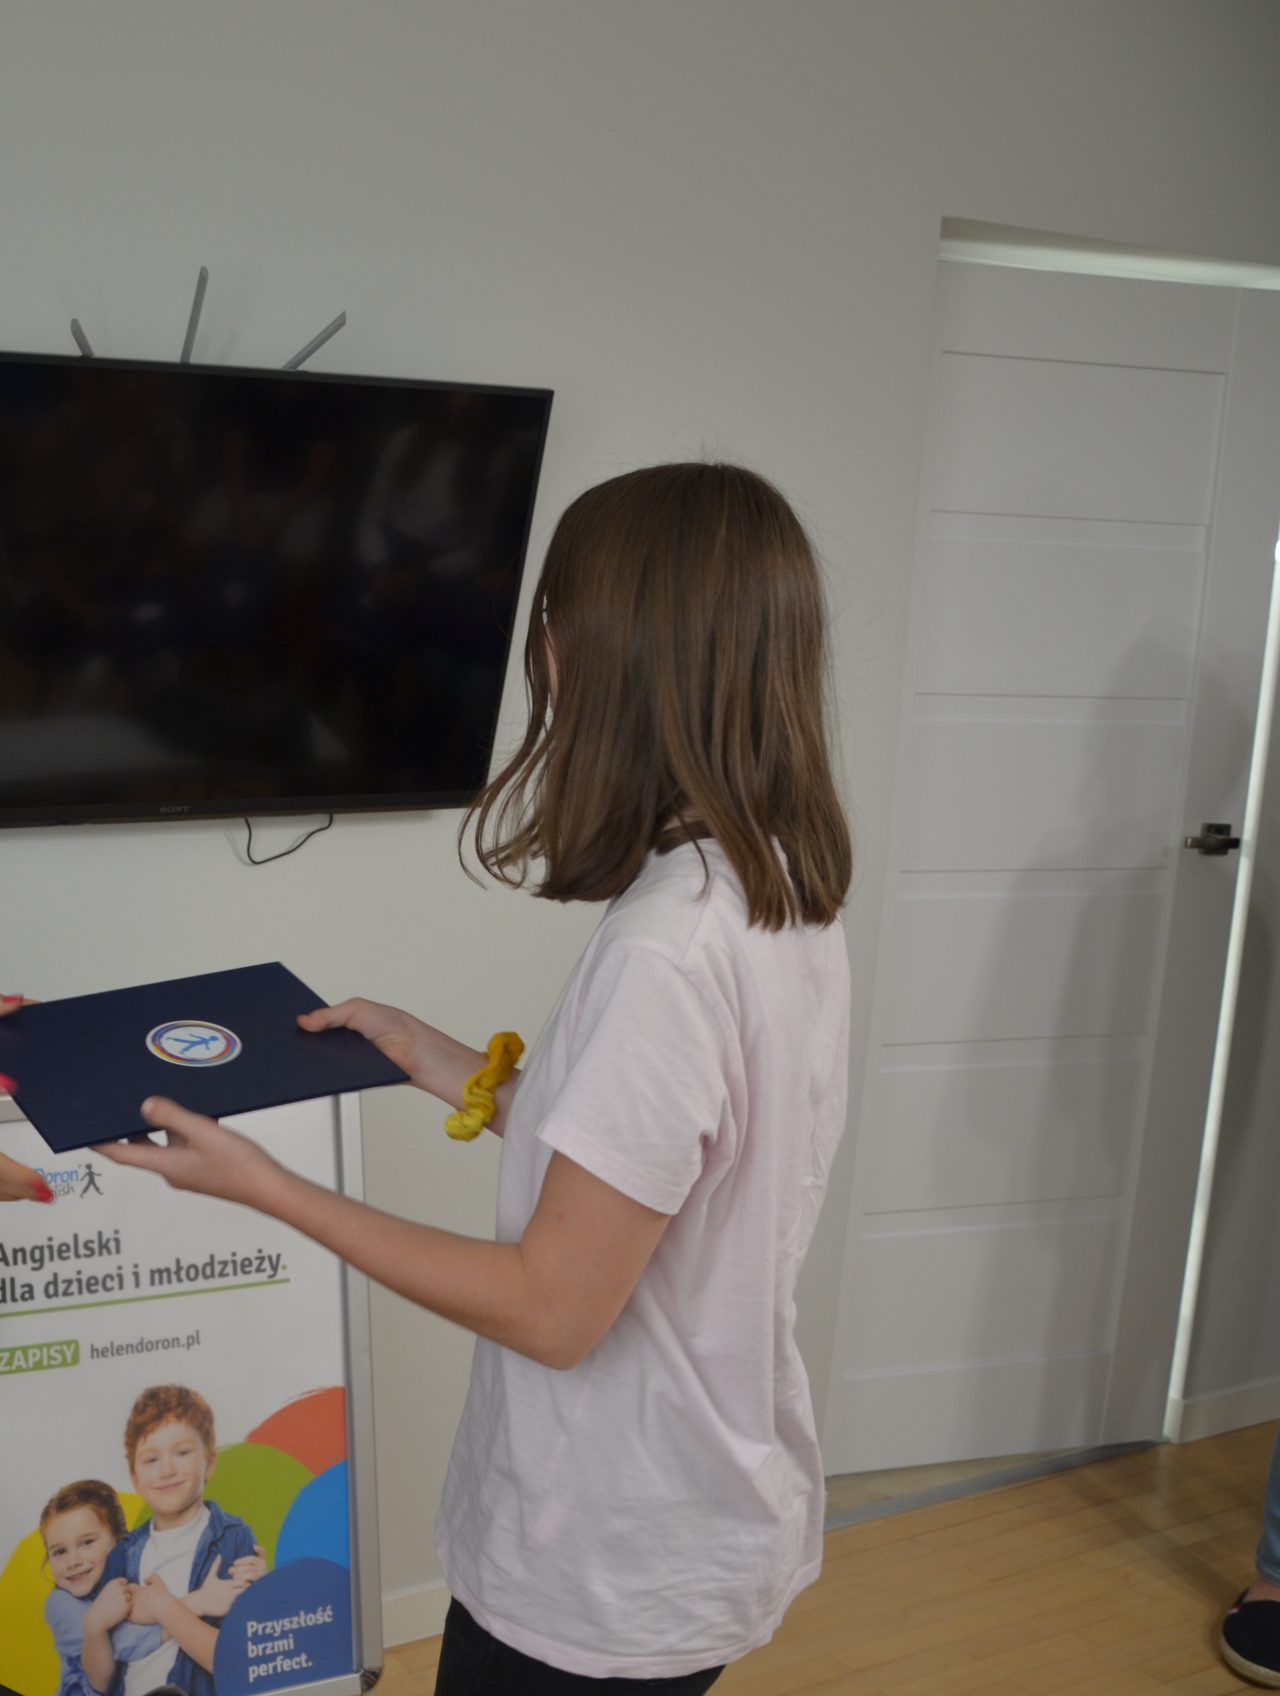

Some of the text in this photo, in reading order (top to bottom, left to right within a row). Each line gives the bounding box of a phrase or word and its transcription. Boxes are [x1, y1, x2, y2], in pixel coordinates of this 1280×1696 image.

[44, 1266, 124, 1300] dzieci
[133, 1264, 141, 1288] i
[149, 1249, 287, 1287] młodzieży.
[90, 1330, 201, 1359] helendoron.pl
[246, 1605, 333, 1637] Przyszłość
[248, 1634, 294, 1658] brzmi
[249, 1653, 313, 1683] perfect.
